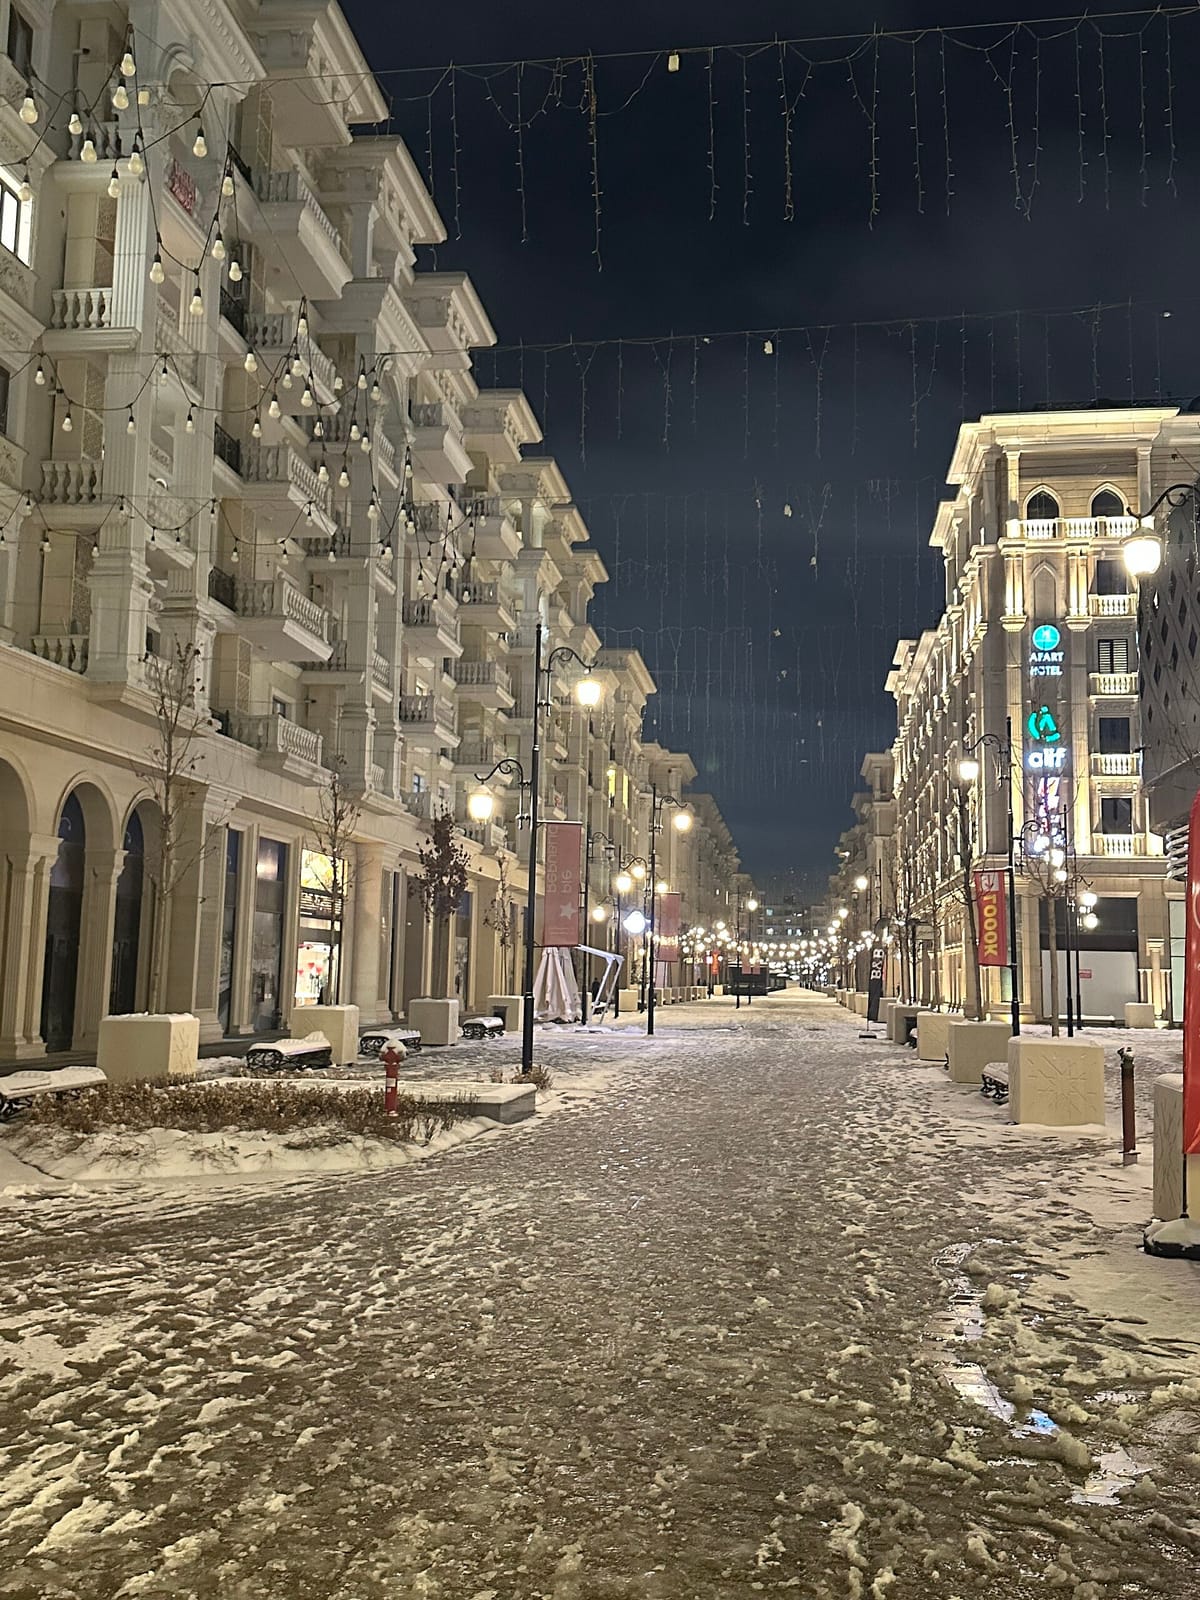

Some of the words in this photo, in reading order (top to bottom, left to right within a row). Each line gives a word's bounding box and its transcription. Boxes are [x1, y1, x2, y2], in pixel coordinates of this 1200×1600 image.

[1030, 666, 1062, 676] HOTEL
[1028, 747, 1067, 768] alif
[871, 948, 885, 980] B&B
